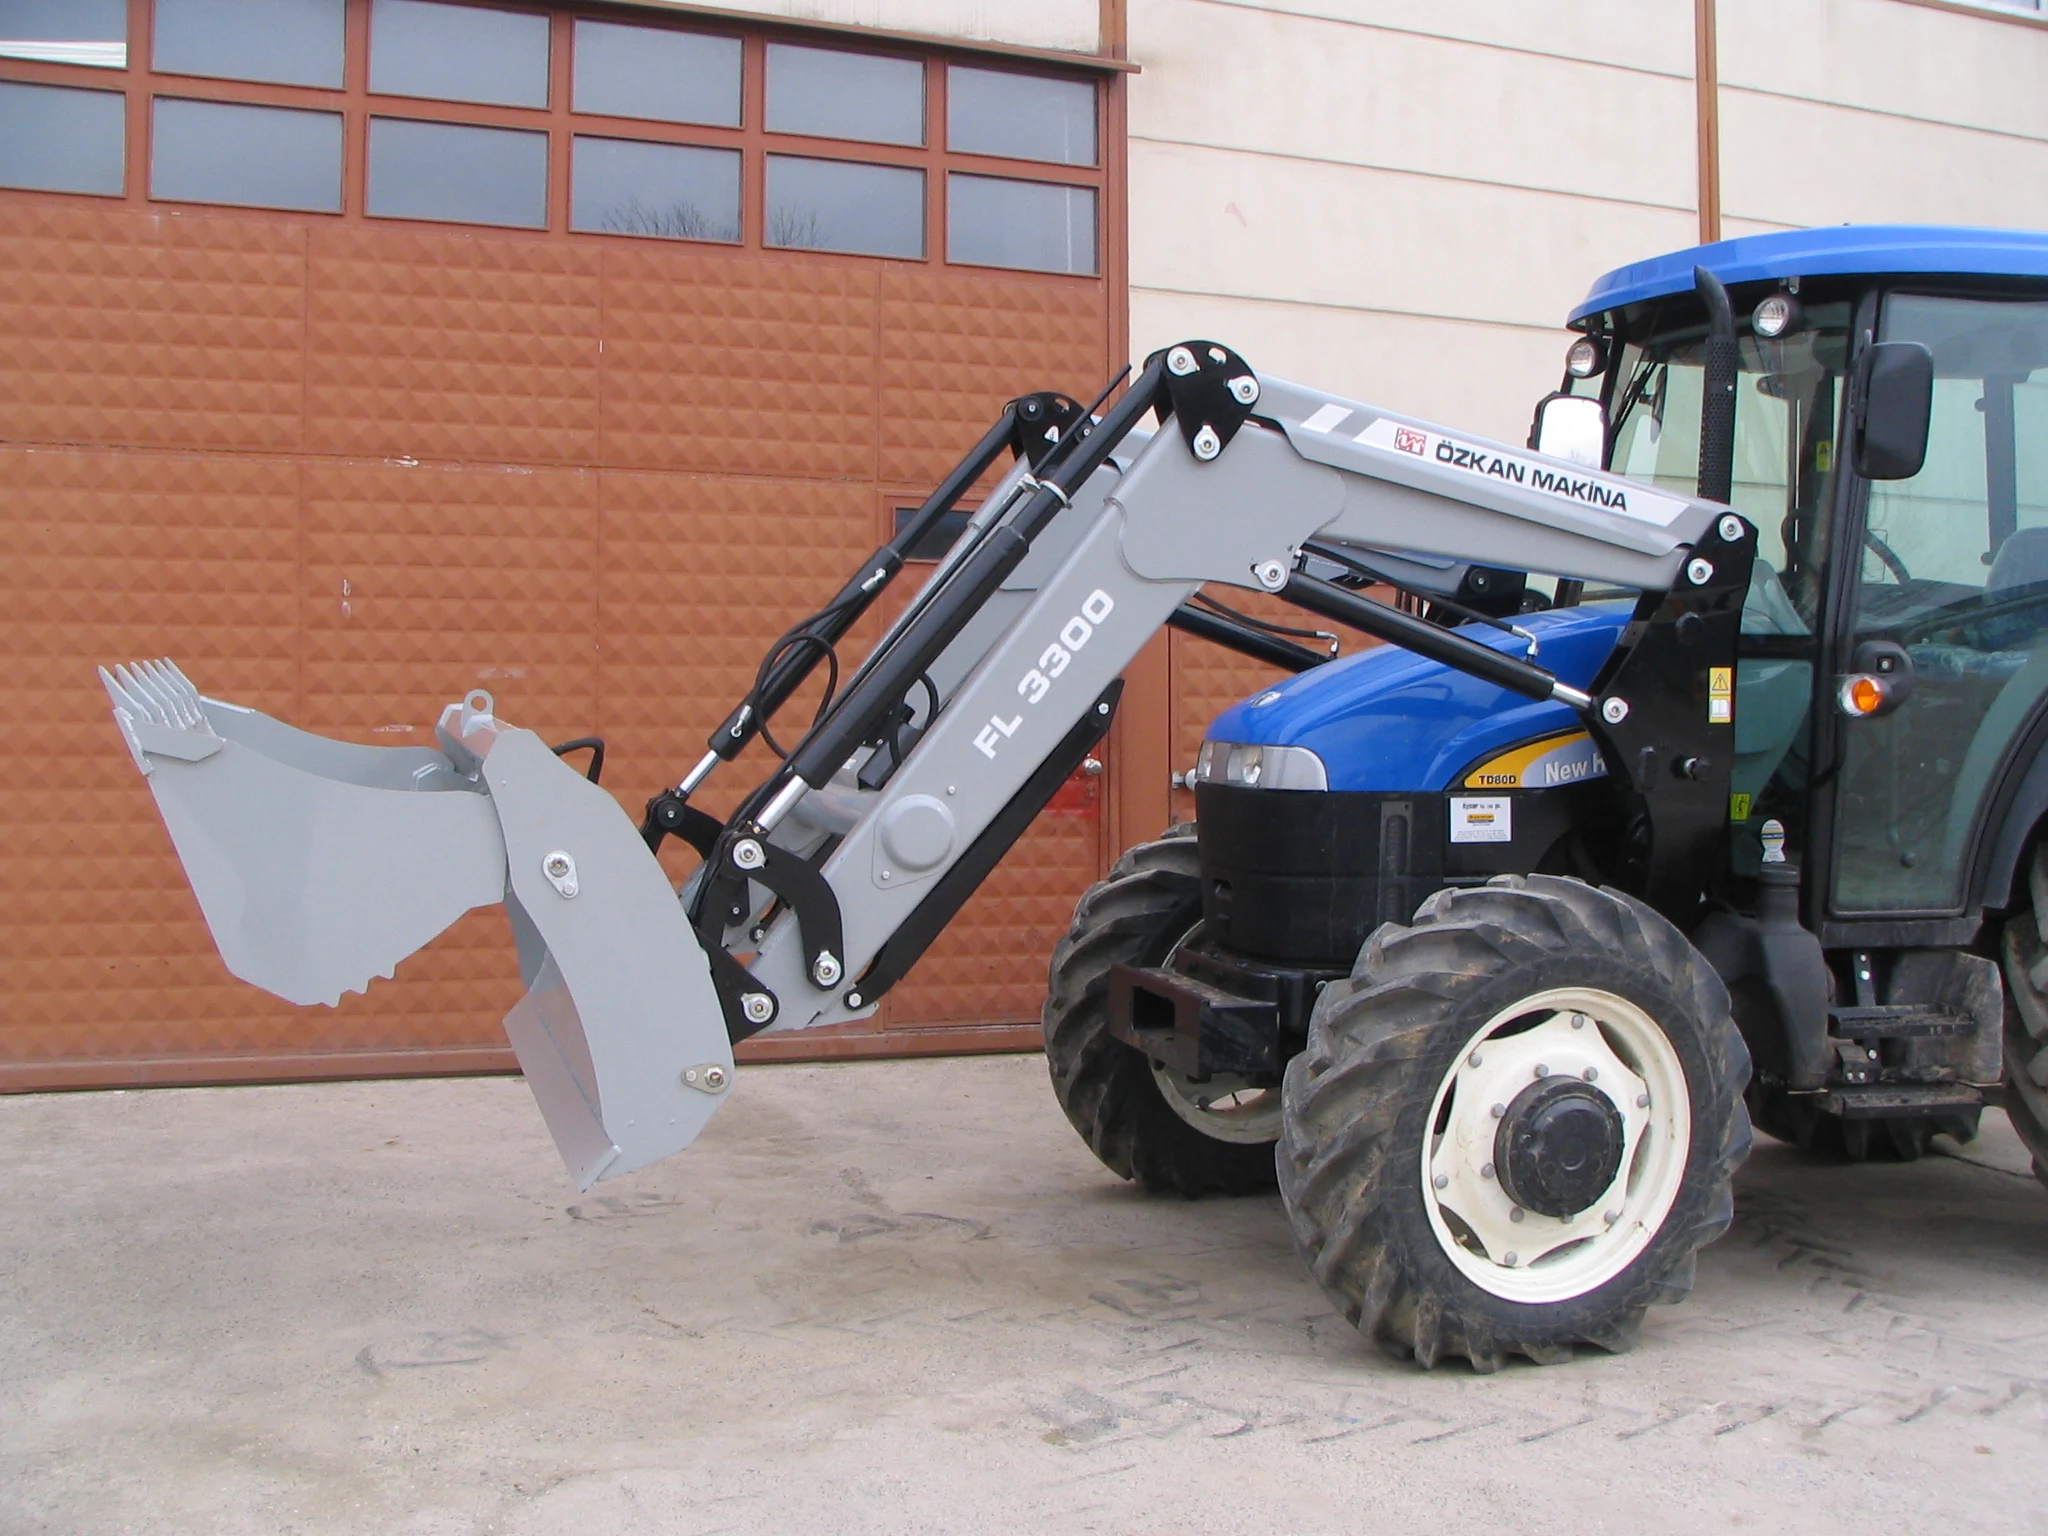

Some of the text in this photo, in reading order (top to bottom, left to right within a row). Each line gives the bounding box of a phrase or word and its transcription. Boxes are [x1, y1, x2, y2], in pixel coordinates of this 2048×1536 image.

[1434, 440, 1525, 483] ÖZKAN
[1531, 470, 1628, 511] MAKİNA
[972, 588, 1115, 760] FL 3300
[1544, 760, 1588, 784] New
